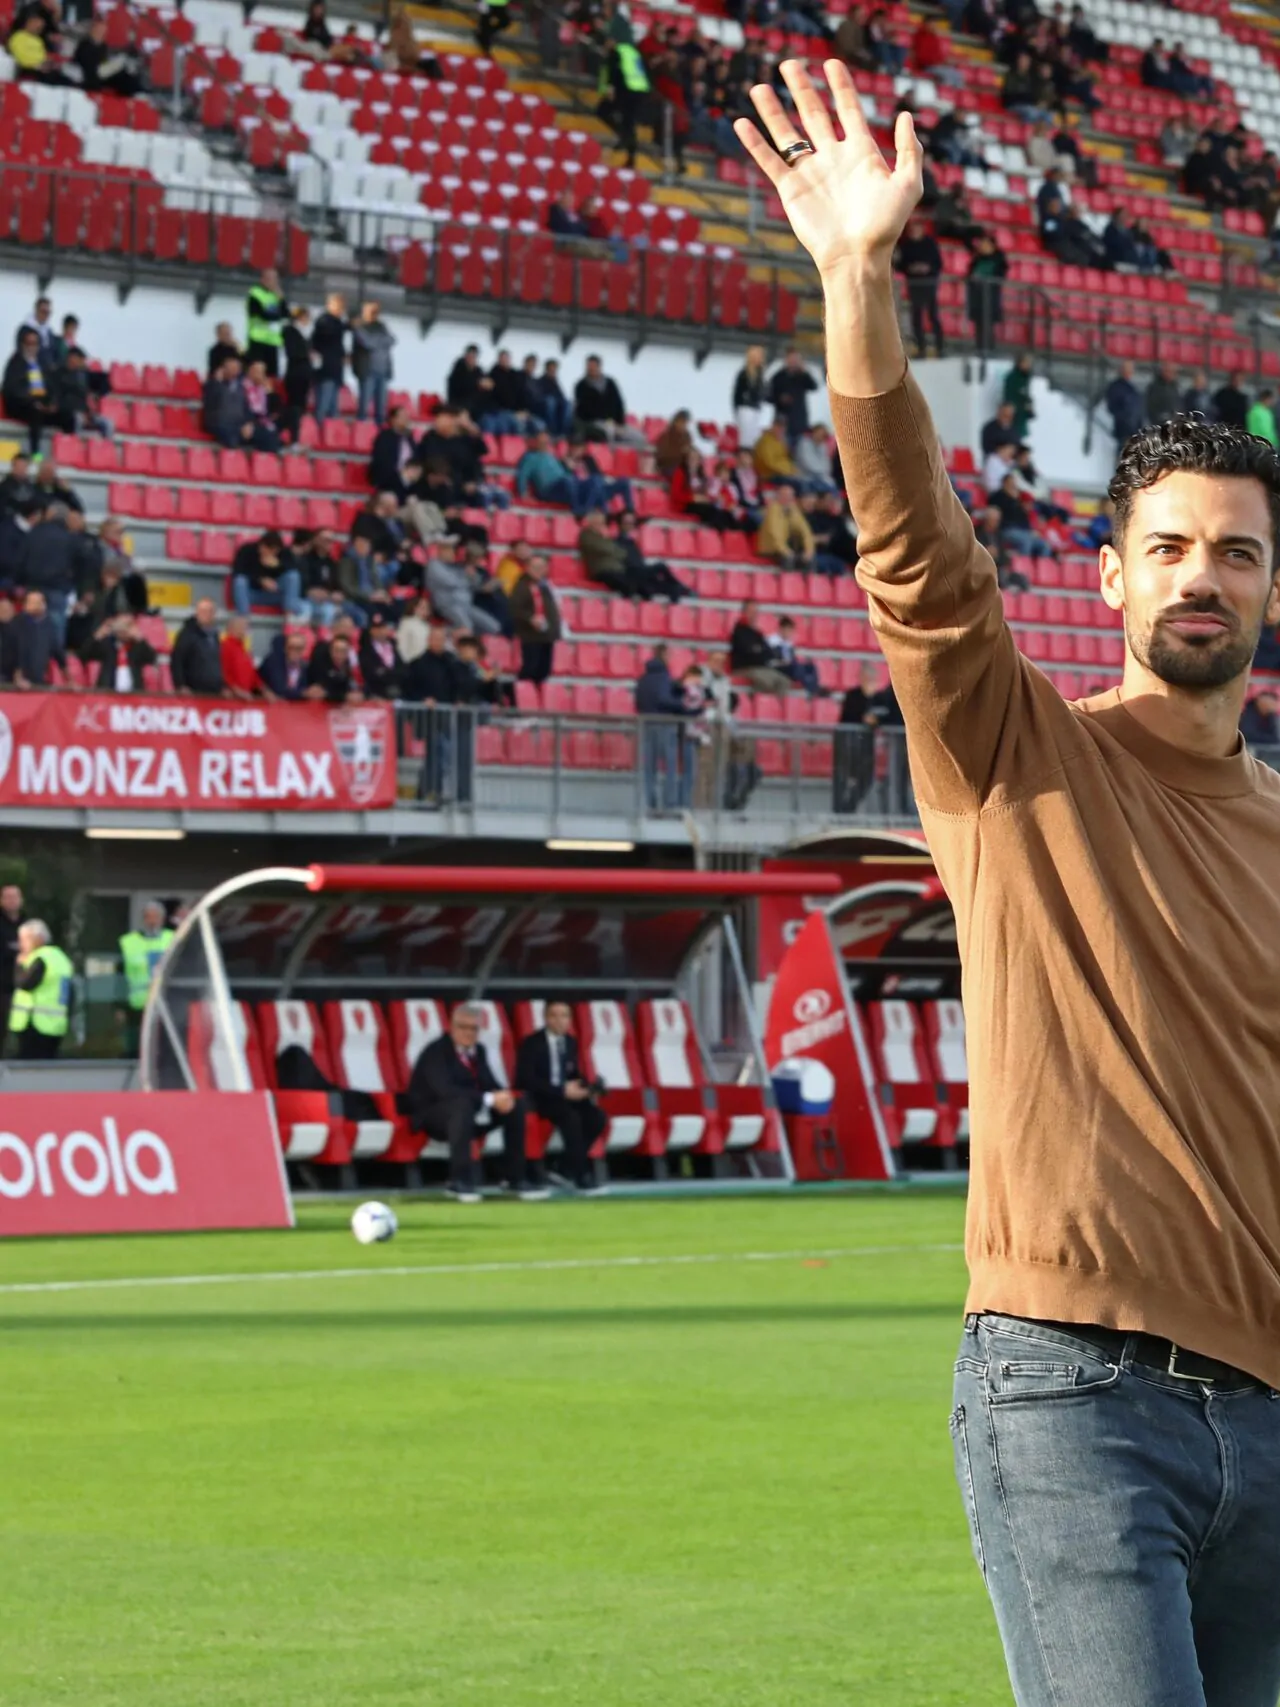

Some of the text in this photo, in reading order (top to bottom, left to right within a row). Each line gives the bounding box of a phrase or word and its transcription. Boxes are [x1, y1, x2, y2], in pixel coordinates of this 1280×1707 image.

[75, 704, 266, 737] AC MONZA CLUB
[18, 745, 335, 798] MONZA RELAX
[0, 1116, 178, 1198] orola
